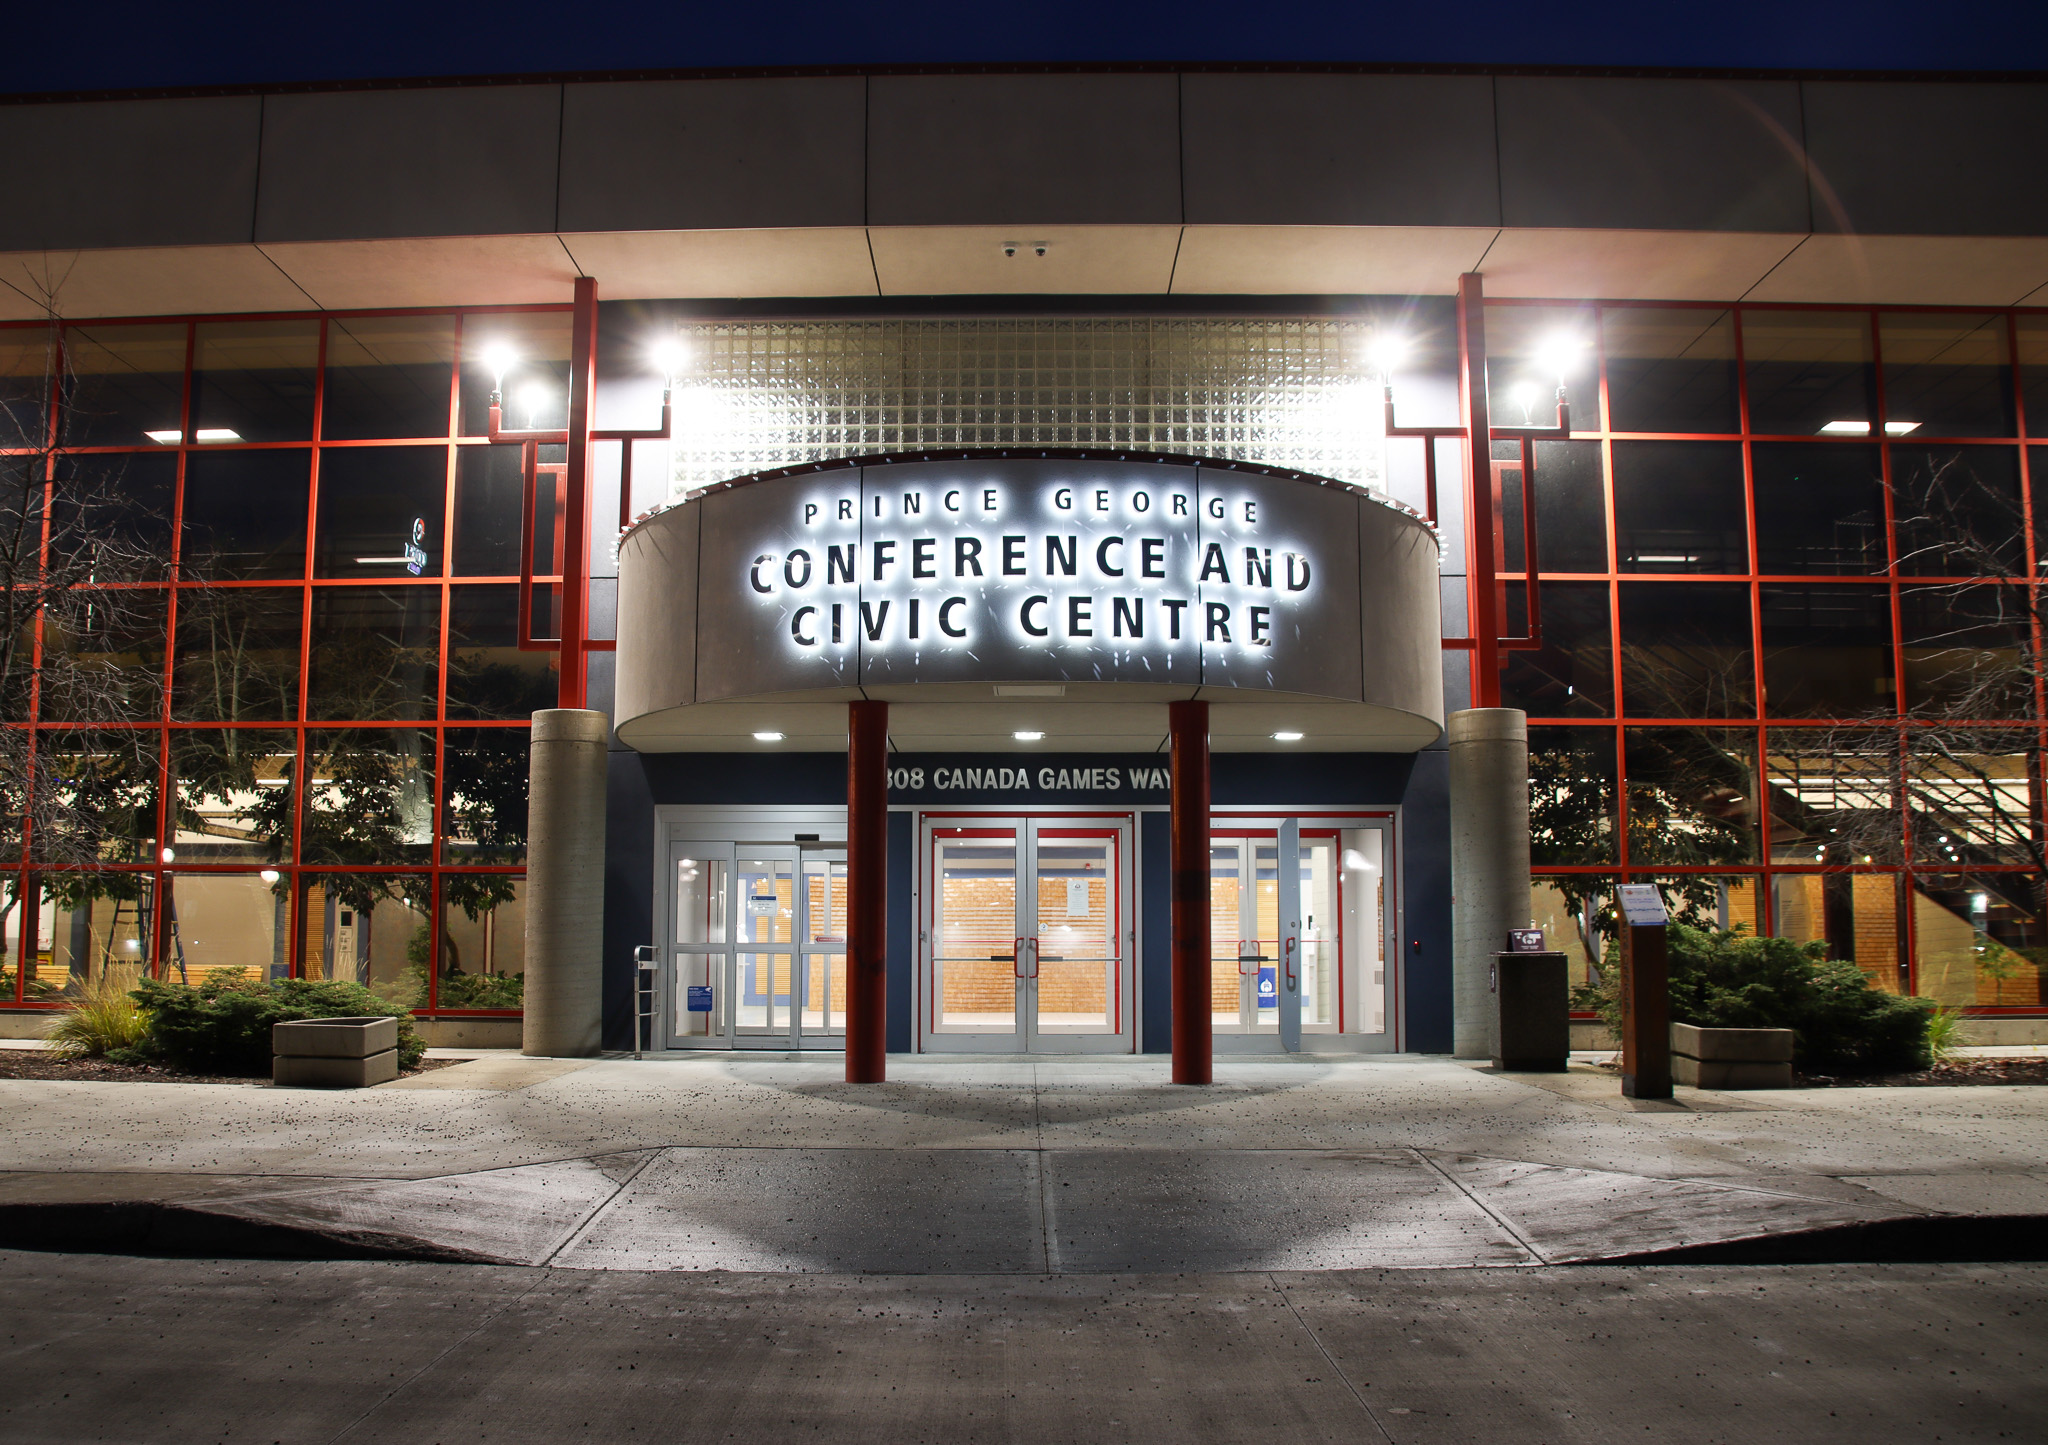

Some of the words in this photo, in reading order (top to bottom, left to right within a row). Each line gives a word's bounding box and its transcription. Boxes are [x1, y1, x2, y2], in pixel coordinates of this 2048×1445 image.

[805, 489, 997, 525] PRINCE
[1055, 488, 1257, 523] GEORGE
[750, 535, 1166, 594] CONFERENCE
[1199, 542, 1311, 592] AND
[791, 596, 967, 646] CIVIC
[1019, 595, 1272, 647] CENTRE
[933, 767, 1031, 790] CANADA
[1038, 767, 1121, 790] GAMES
